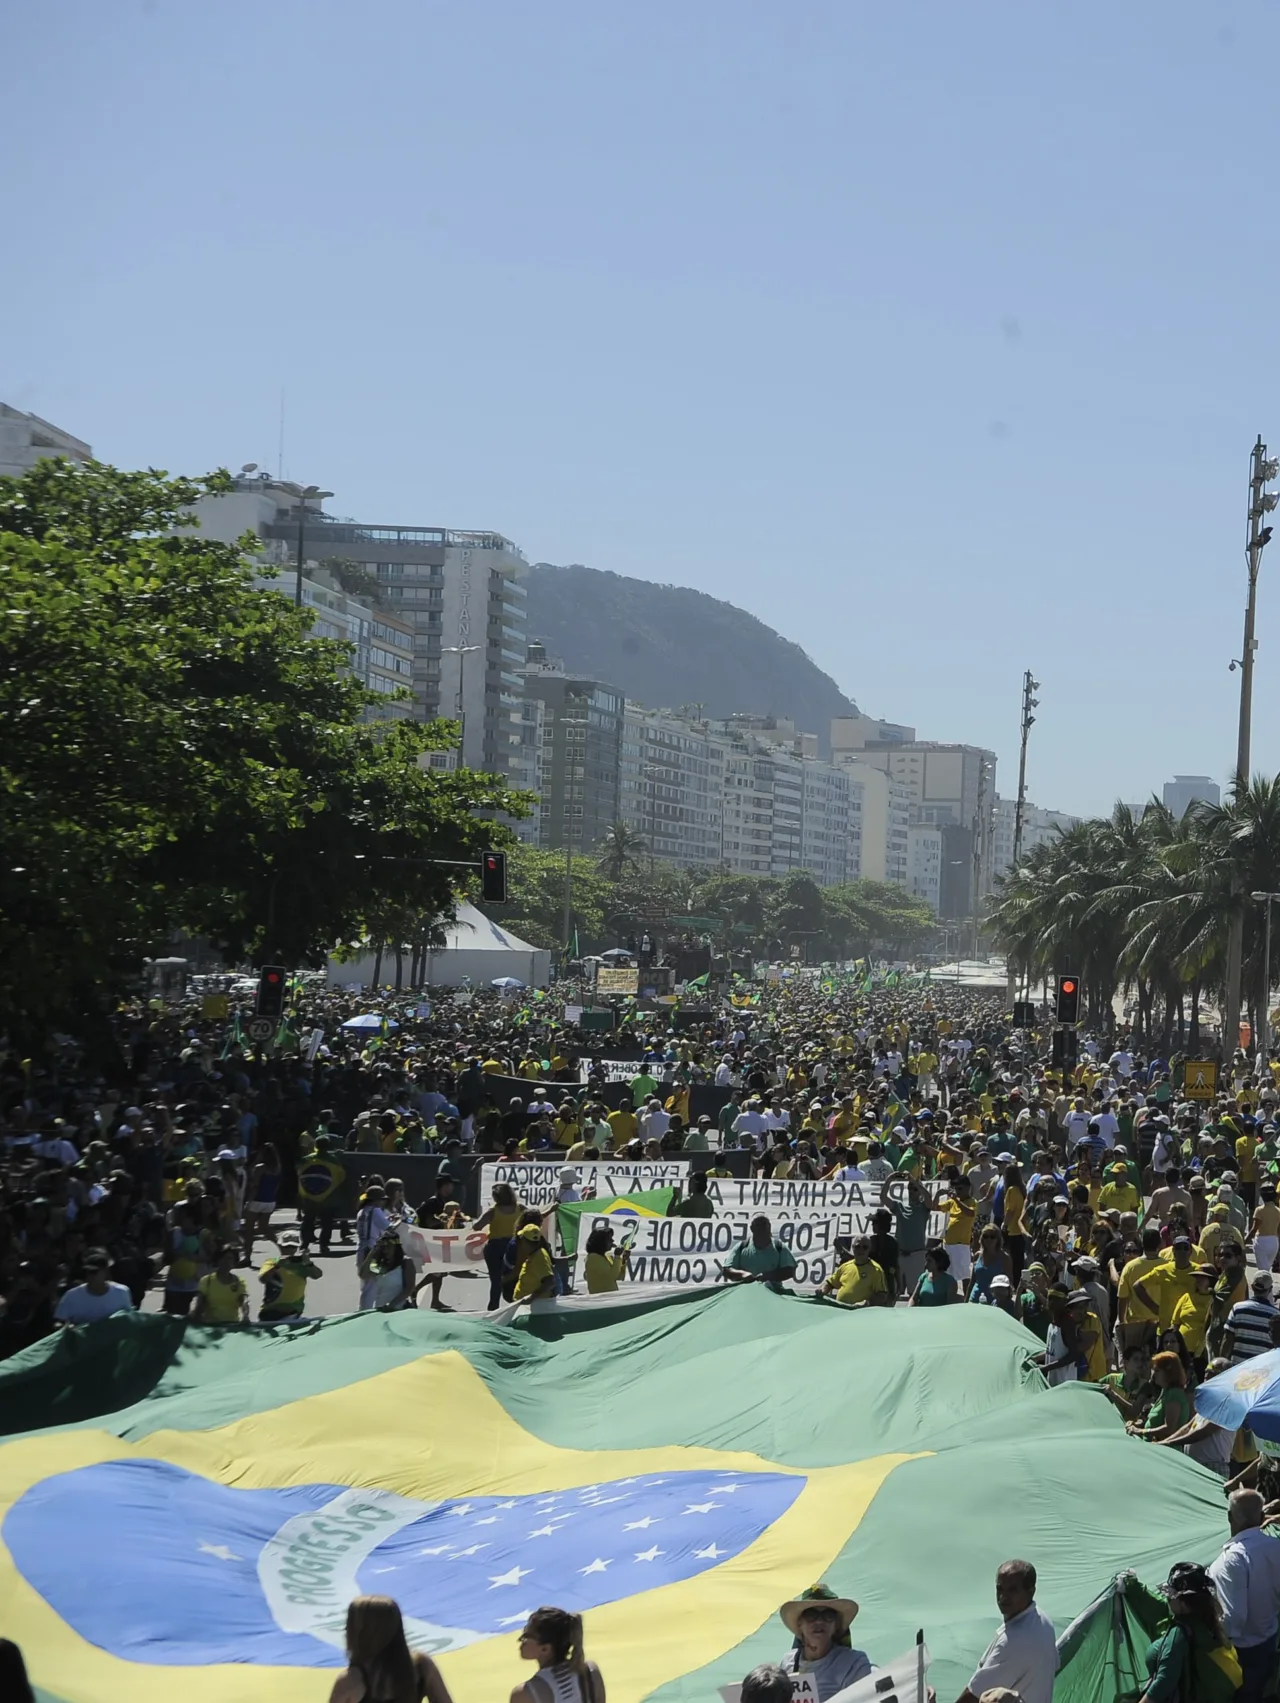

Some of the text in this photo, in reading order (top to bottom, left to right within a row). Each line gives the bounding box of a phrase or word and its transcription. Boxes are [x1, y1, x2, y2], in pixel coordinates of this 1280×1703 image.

[459, 549, 471, 647] PESTANA
[252, 1022, 270, 1034] 70
[278, 1503, 396, 1606] PROGRESSO
[793, 1680, 812, 1692] RA
